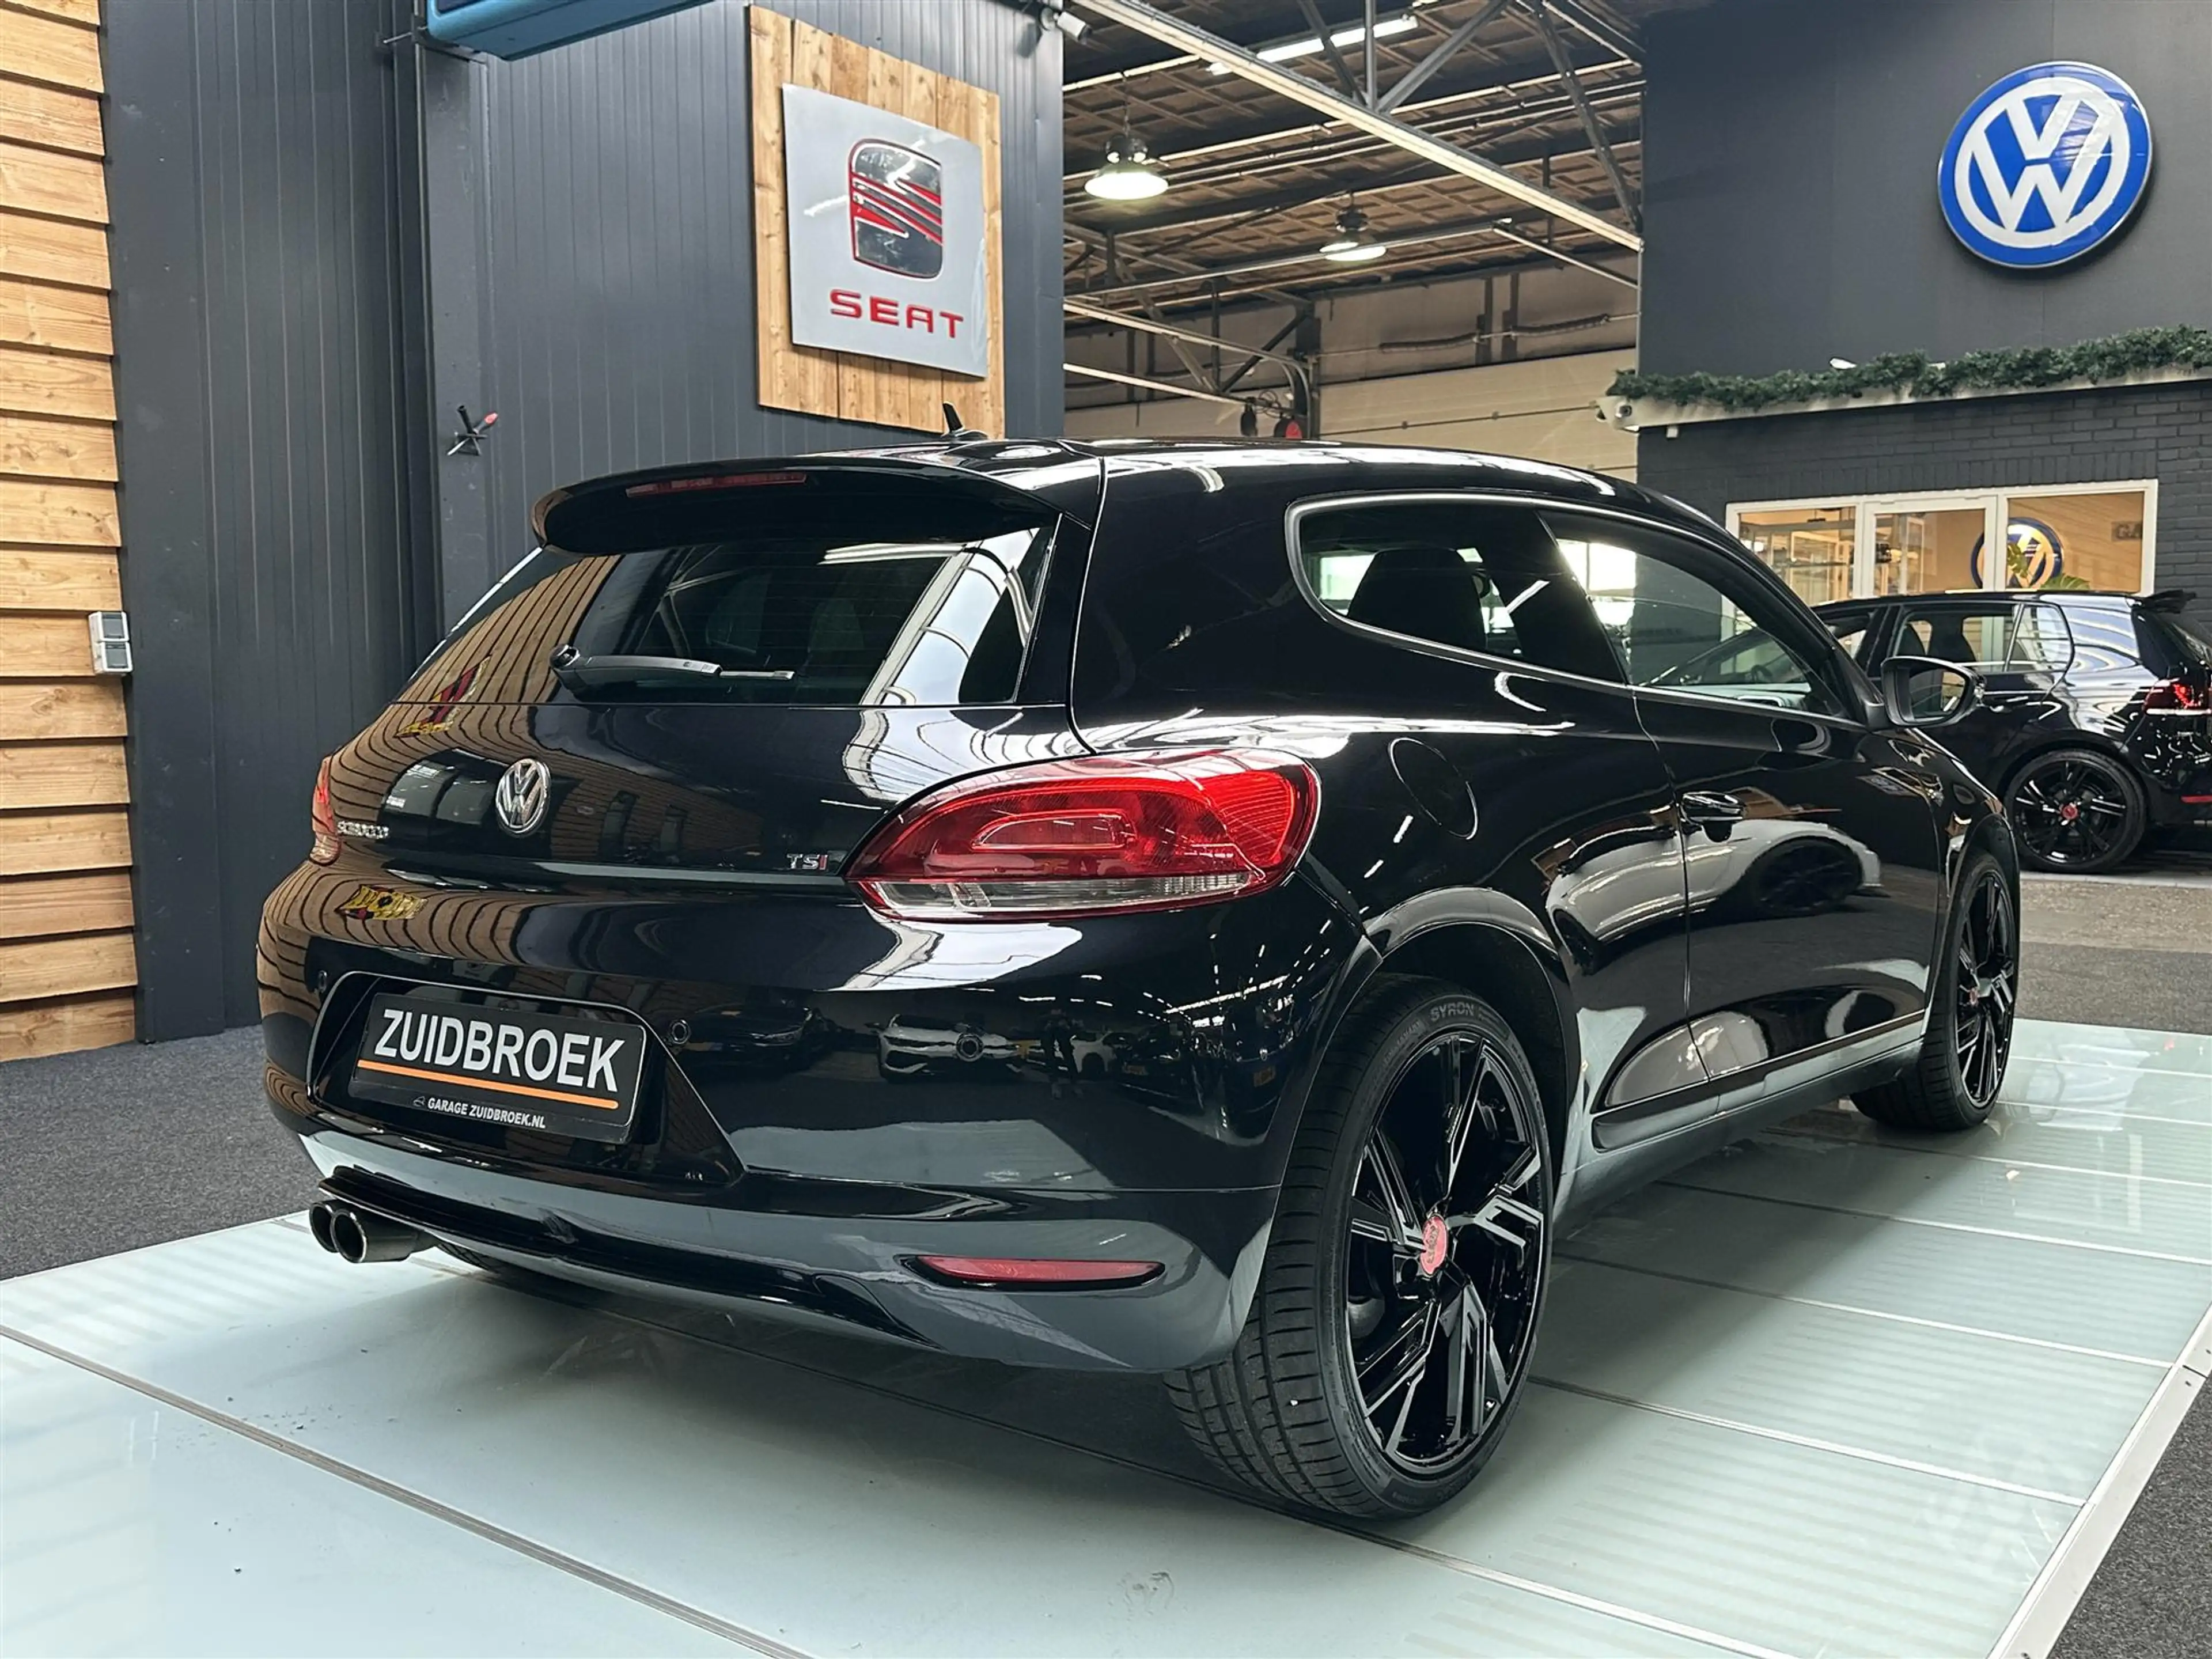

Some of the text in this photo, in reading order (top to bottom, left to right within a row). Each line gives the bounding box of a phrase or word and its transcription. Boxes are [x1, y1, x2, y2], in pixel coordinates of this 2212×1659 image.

[830, 289, 964, 339] SEAT
[786, 853, 828, 871] TSI
[1430, 1001, 1475, 1022] SYRON
[374, 1009, 626, 1093] ZUIDBROEK
[427, 1097, 547, 1129] GARAGE ZUIDBROEK.NL
